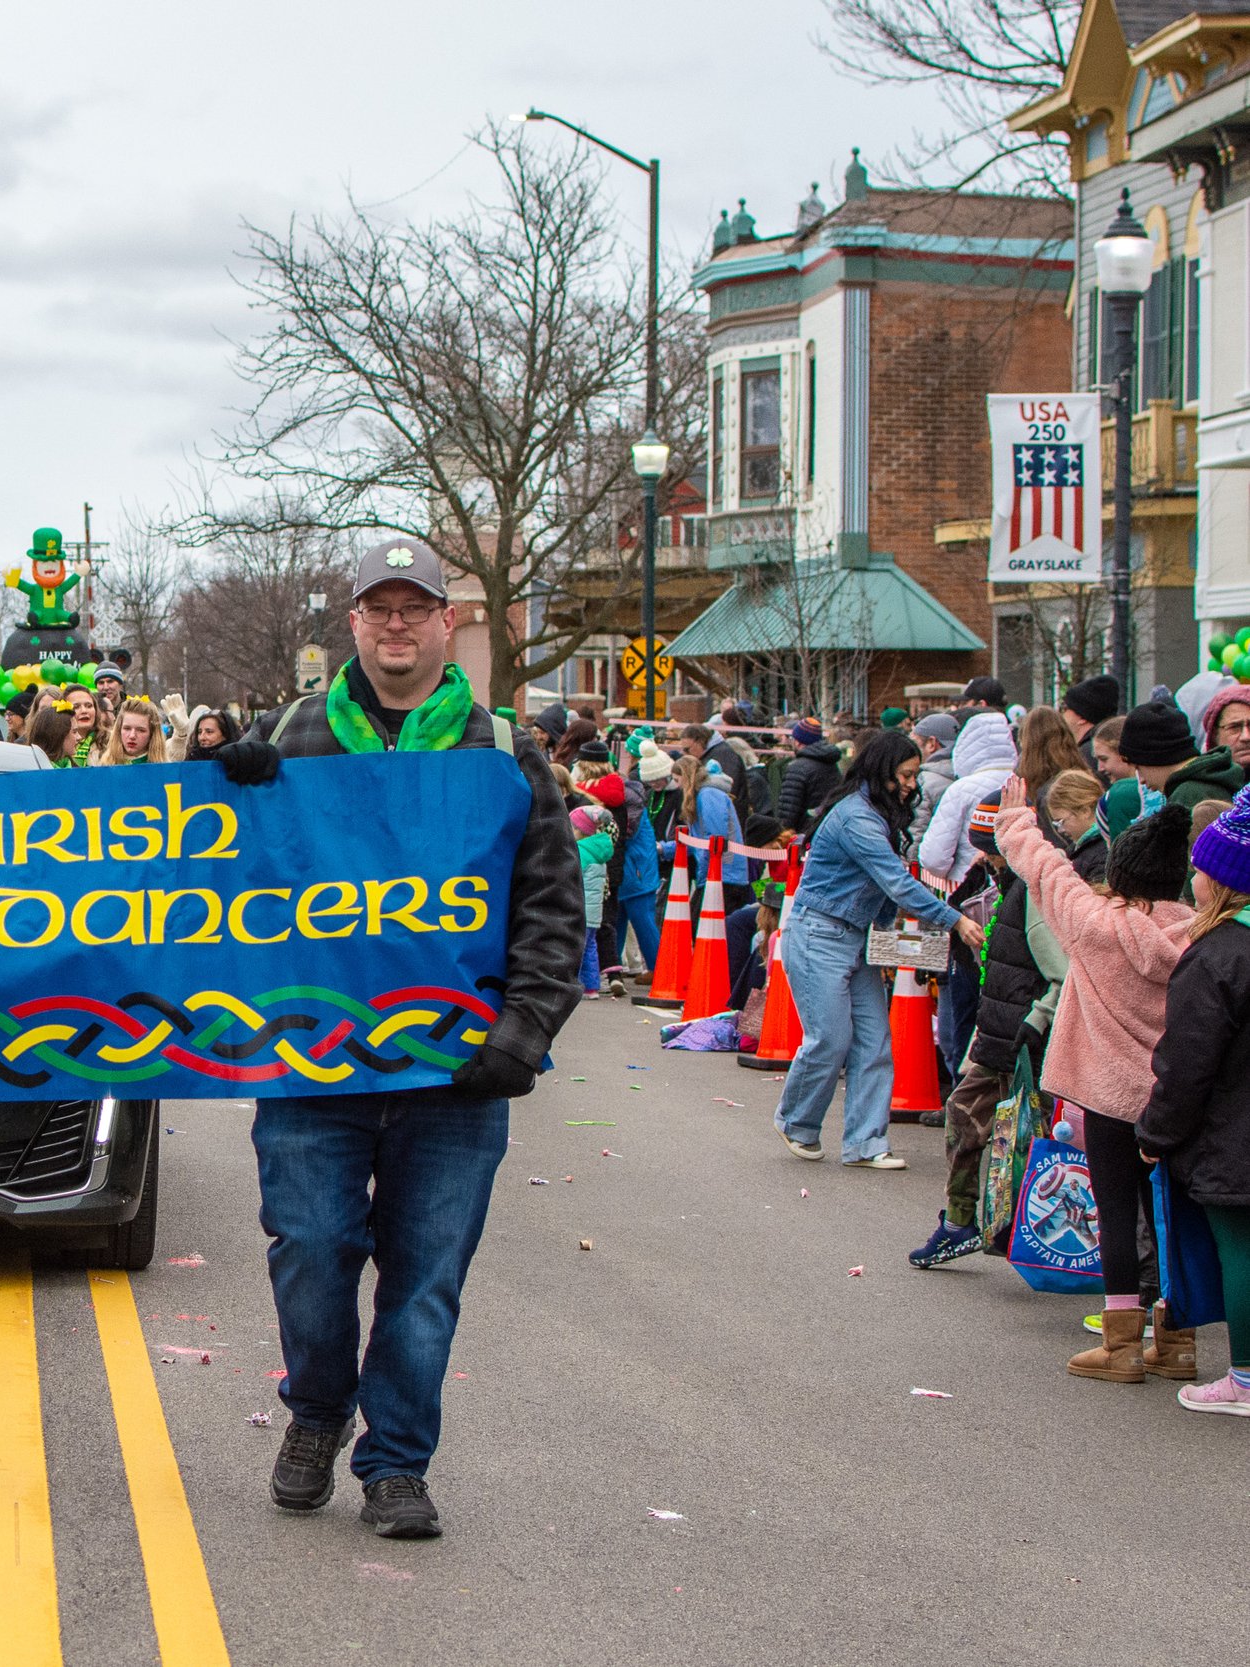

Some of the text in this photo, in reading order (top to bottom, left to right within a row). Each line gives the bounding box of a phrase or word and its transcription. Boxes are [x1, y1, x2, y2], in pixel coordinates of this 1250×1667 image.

[1019, 401, 1070, 422] USA
[1028, 423, 1066, 442] 250
[1008, 559, 1083, 571] GRAYSLAKE
[39, 651, 73, 660] HAPPY
[626, 656, 669, 669] R R
[1035, 1152, 1061, 1173] SAM
[1020, 1225, 1066, 1267] CAPTAIN
